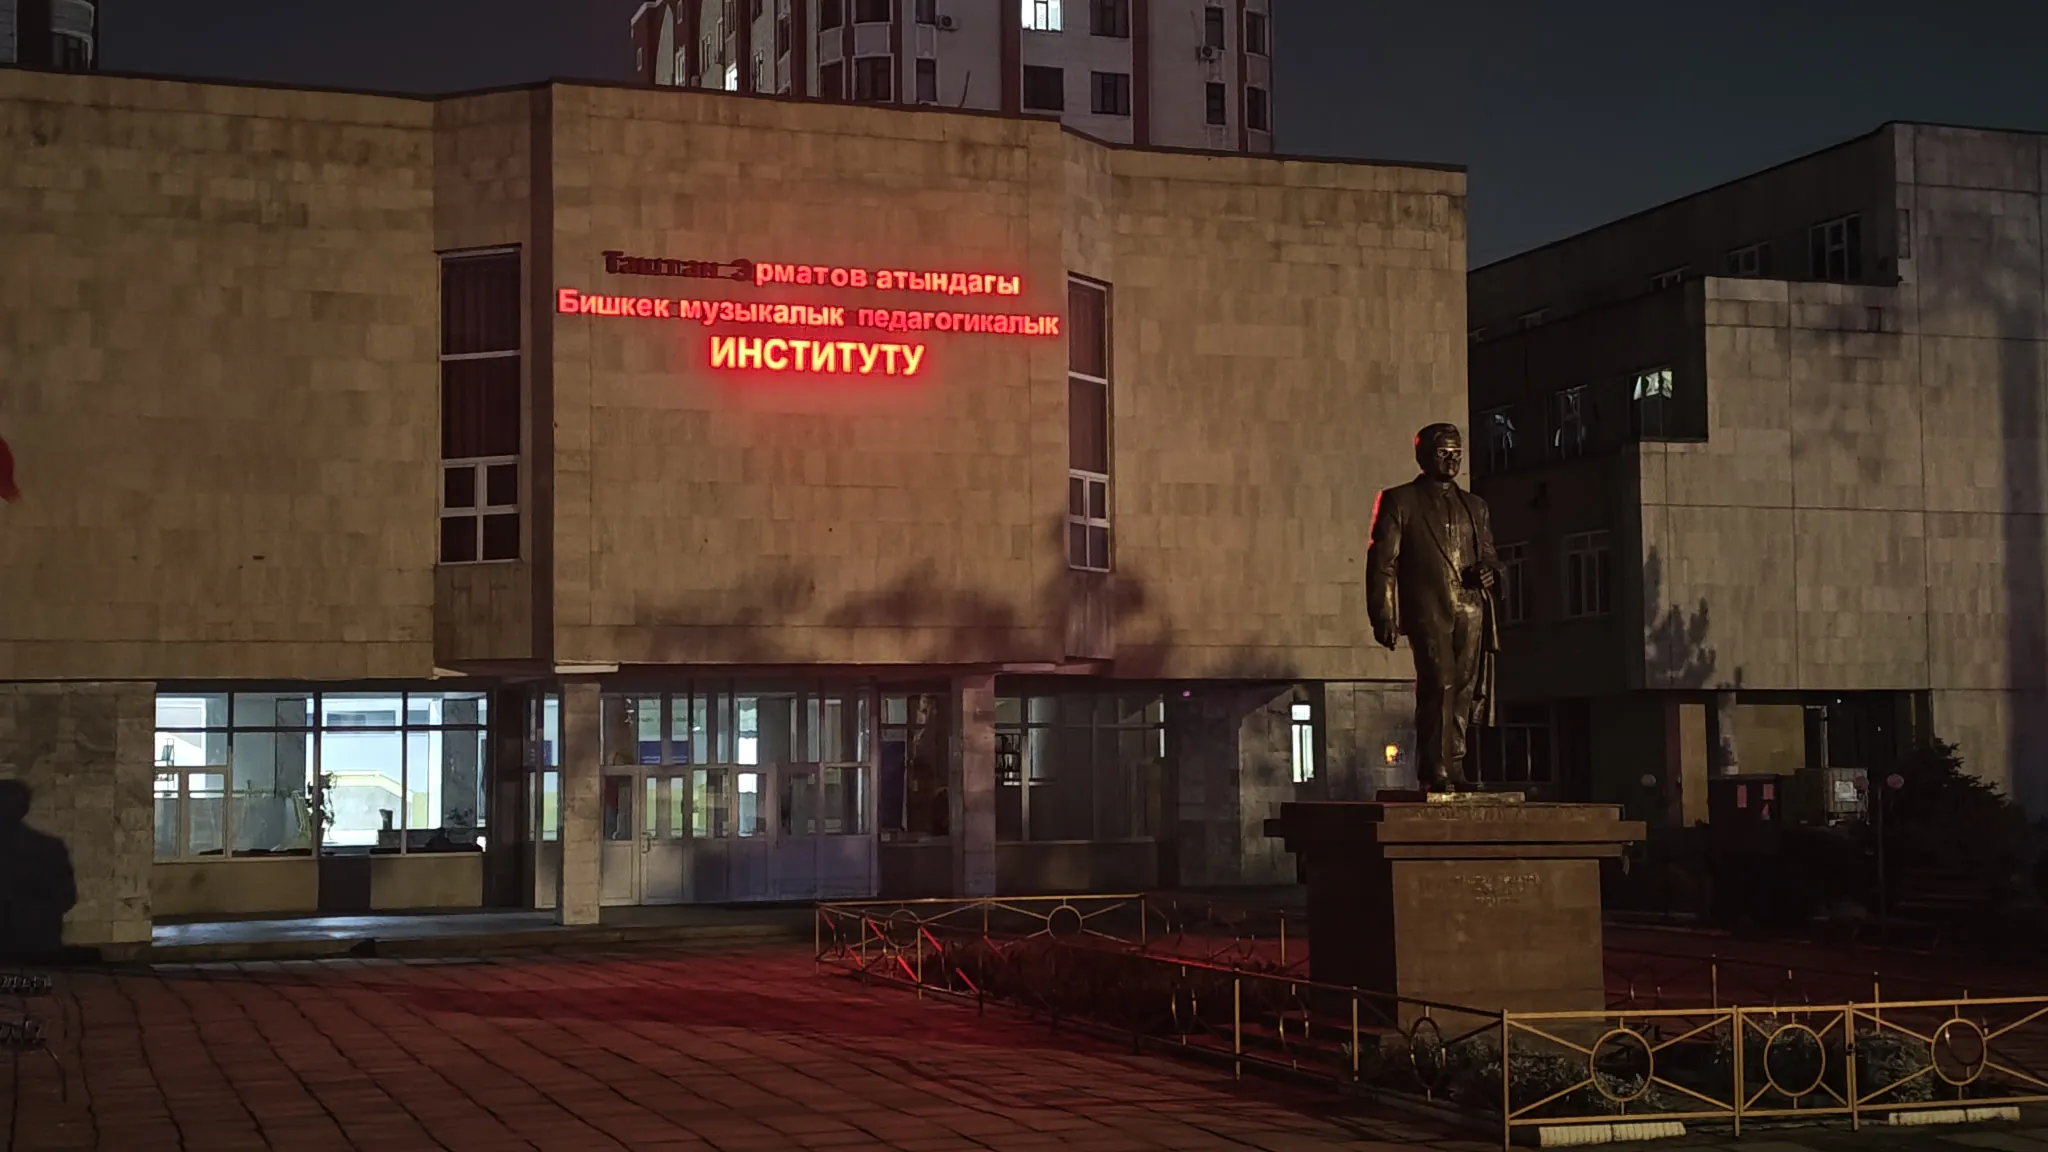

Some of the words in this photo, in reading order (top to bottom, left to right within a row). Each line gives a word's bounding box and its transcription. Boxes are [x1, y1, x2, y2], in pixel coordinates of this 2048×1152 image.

[875, 269, 1021, 296] атындагы
[557, 287, 671, 319] Бишкек
[678, 298, 845, 327] музыкалык
[857, 308, 1060, 336] педагогикалык
[709, 335, 925, 376] ИНСТИТУТУ
